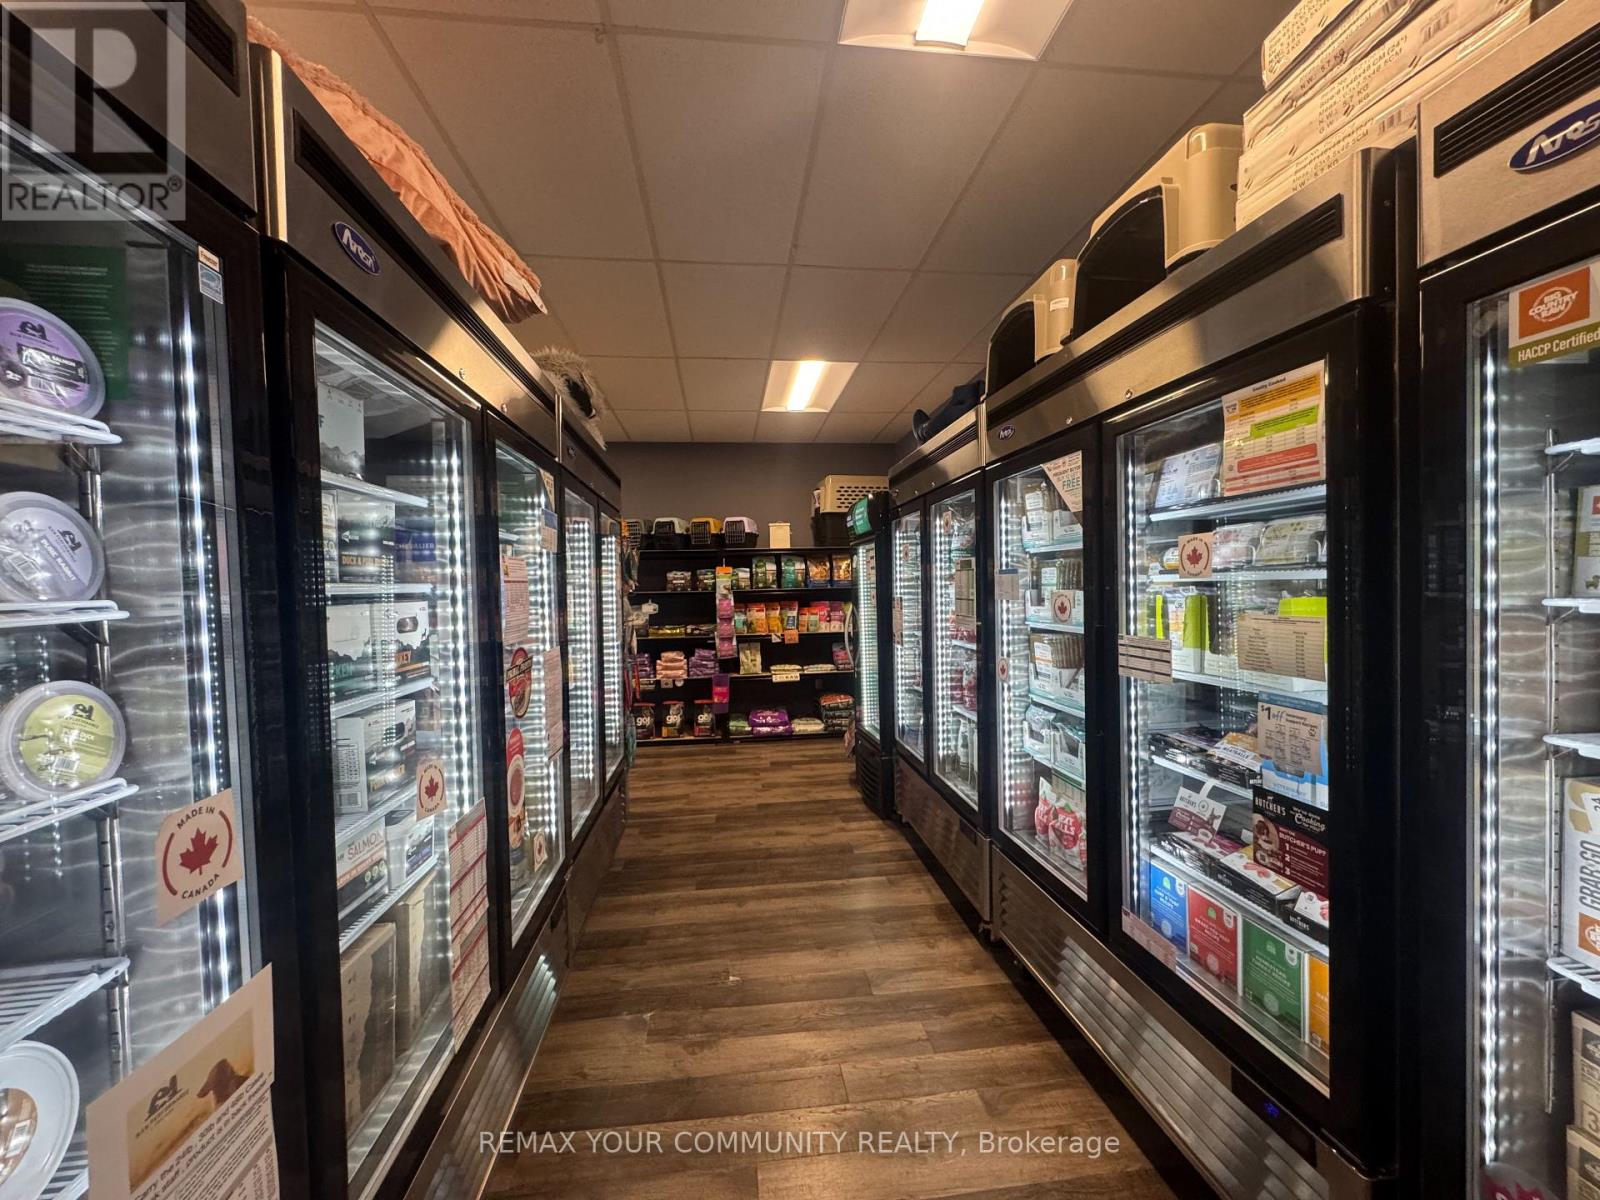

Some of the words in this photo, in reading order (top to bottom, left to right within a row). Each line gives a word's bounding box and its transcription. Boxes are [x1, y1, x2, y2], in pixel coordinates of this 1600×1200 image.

[1518, 343, 1551, 362] HACCP
[177, 806, 204, 830] MADE
[205, 805, 216, 815] IN
[347, 828, 385, 860] SALMON
[181, 872, 220, 900] CANADA
